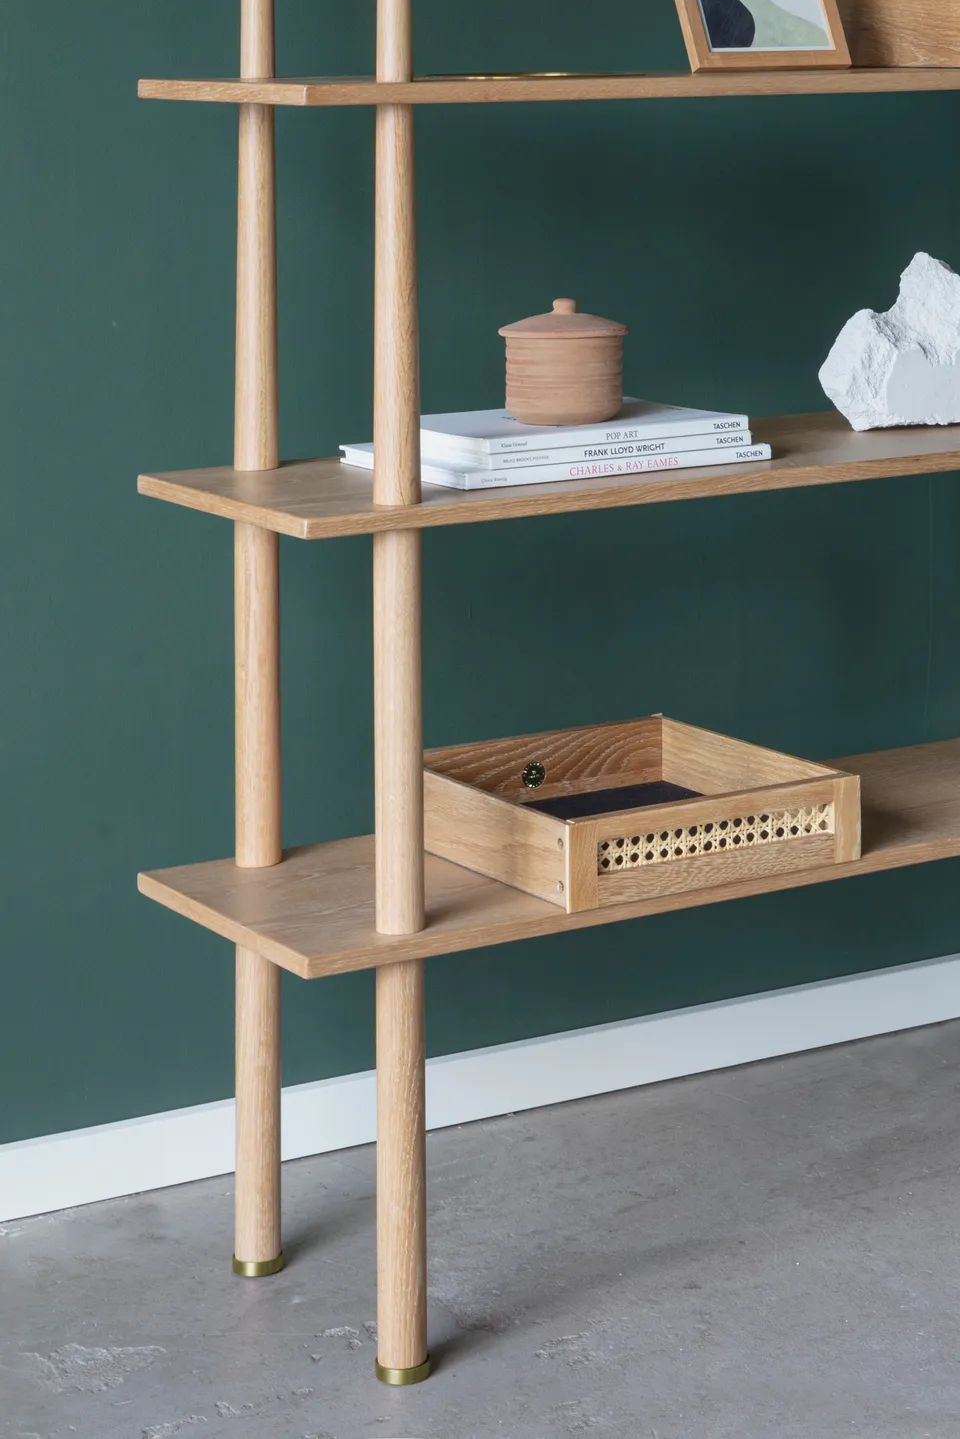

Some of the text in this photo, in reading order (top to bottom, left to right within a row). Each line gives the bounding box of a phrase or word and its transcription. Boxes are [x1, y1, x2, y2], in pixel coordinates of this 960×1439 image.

[713, 422, 741, 430] TASCHEN
[606, 430, 639, 440] POP ART
[716, 436, 744, 444] TASCHEN
[584, 443, 665, 457] FRANK LLOYD WRIGHT
[736, 450, 763, 458] TASCHEN
[569, 463, 614, 476] CHARLES
[626, 460, 644, 470] RAY
[647, 457, 679, 468] EAMES
